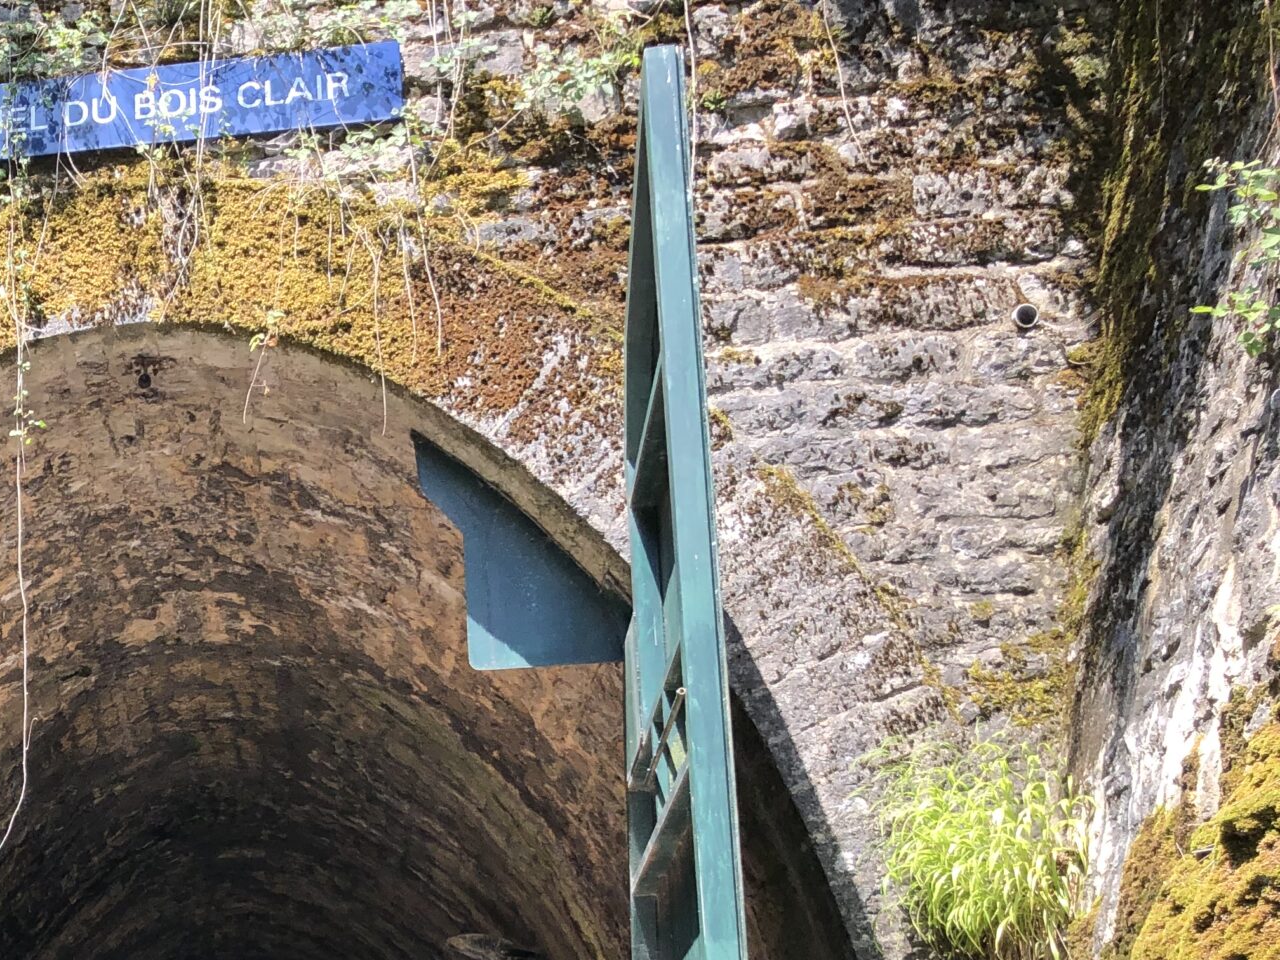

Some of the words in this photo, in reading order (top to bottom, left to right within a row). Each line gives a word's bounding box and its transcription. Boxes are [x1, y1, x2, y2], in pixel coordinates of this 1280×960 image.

[64, 95, 117, 127] DU
[134, 85, 223, 120] BOIS
[237, 71, 350, 109] CLAIR
